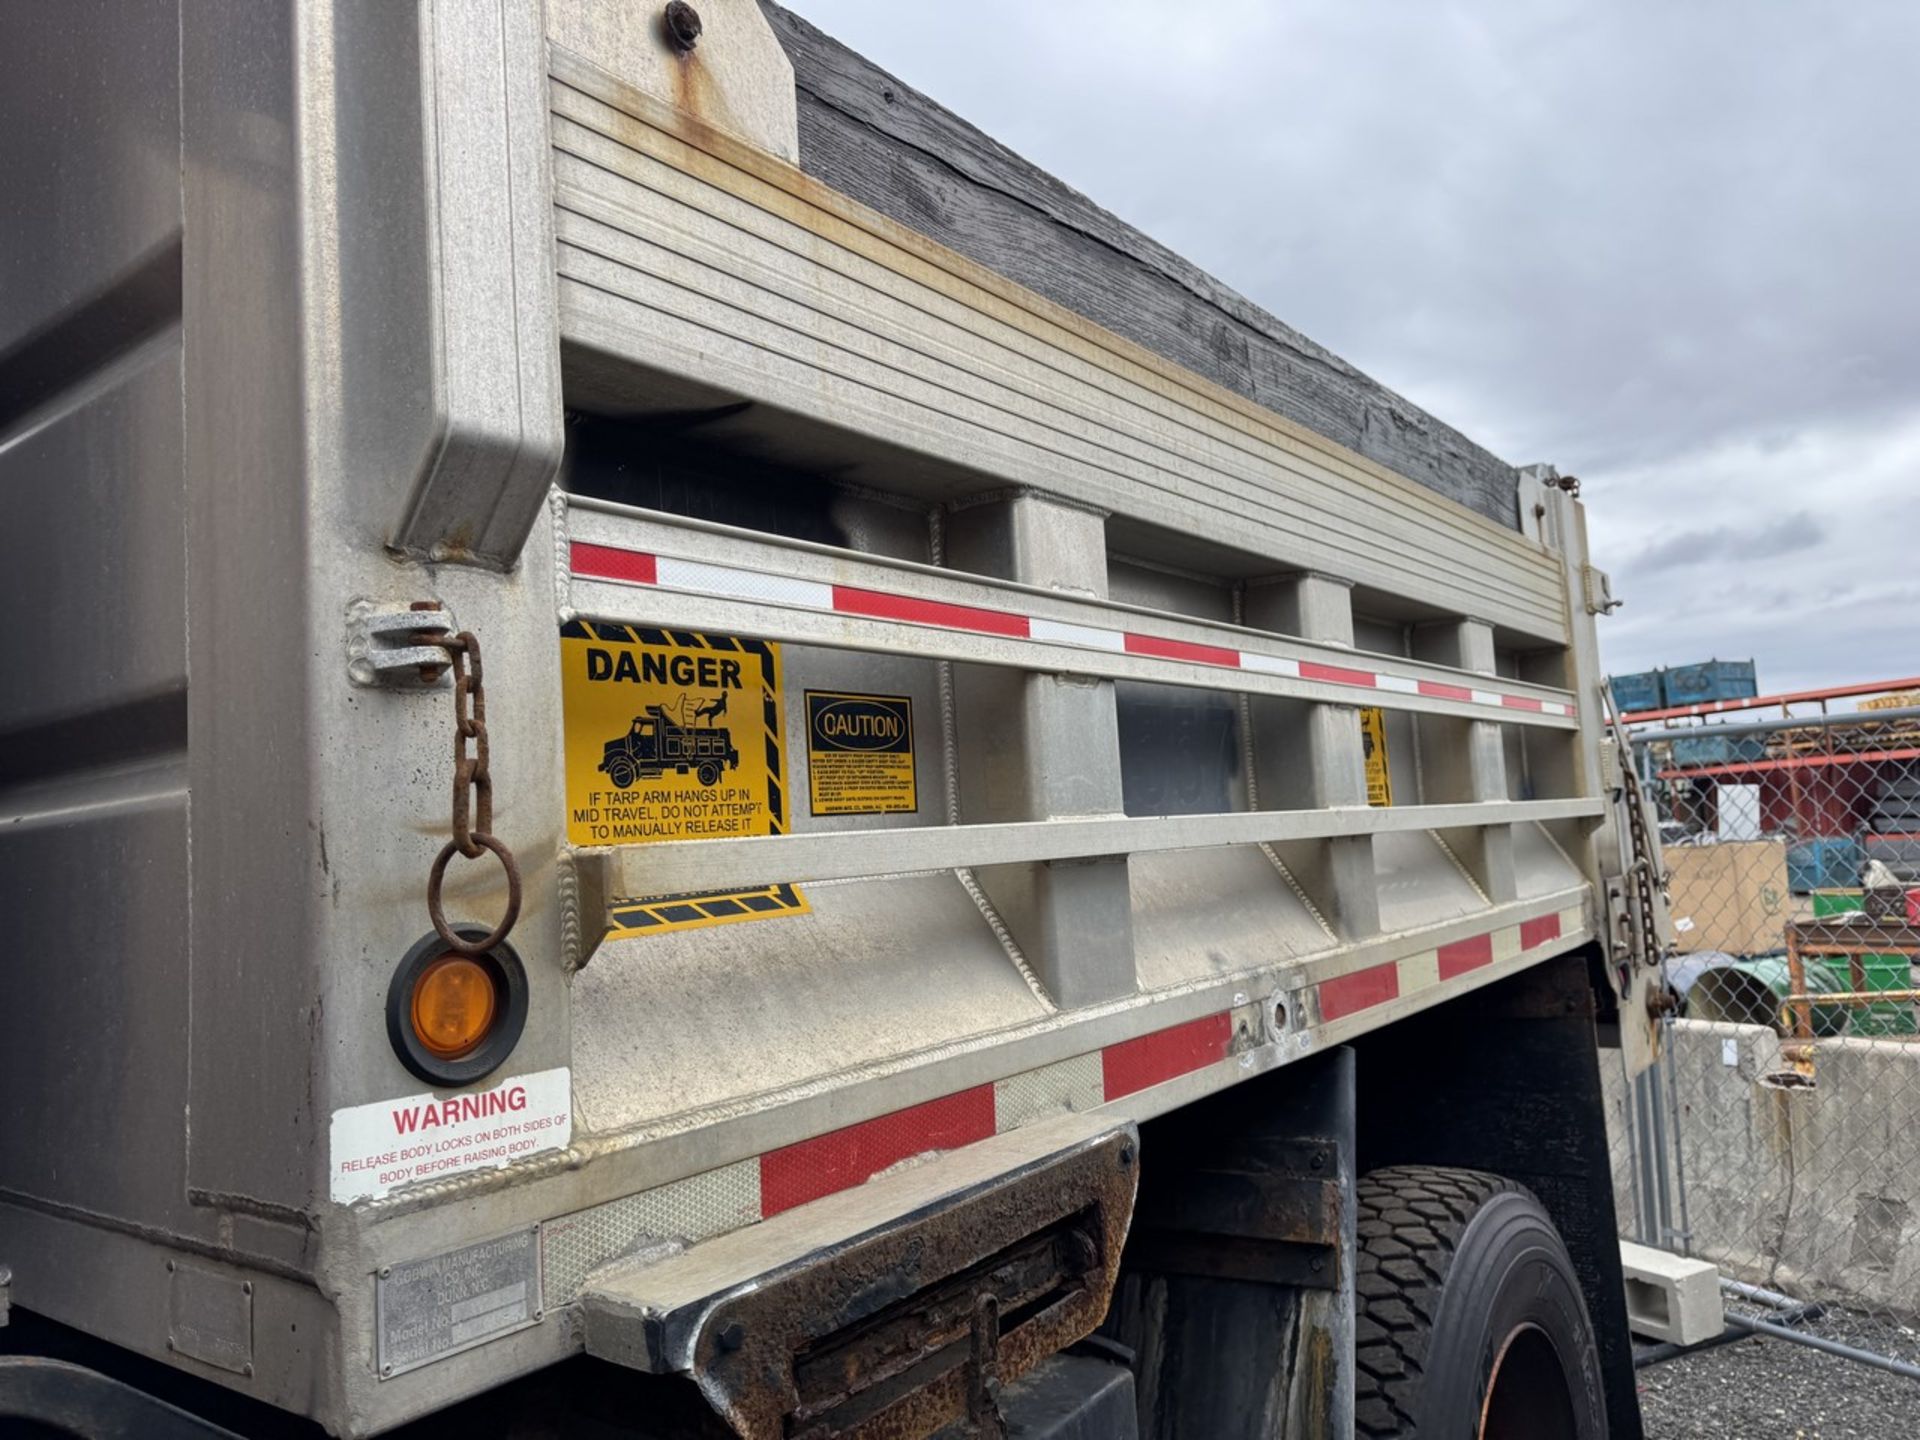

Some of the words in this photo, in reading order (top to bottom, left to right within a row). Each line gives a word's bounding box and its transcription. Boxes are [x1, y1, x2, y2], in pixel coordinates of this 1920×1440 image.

[587, 648, 742, 689] DANGER
[824, 713, 898, 737] CAUTION
[573, 809, 600, 823] MID
[603, 806, 658, 822] TRAVEL,
[661, 805, 680, 820] DO
[684, 804, 709, 818] NOT
[711, 802, 763, 817] ATTEMPT
[589, 792, 601, 806] IF
[605, 791, 640, 806] TARP
[643, 790, 671, 804] ARM
[674, 789, 717, 803] HANGS
[720, 788, 736, 801] UP
[739, 788, 750, 800] IN
[590, 825, 610, 839] TO
[613, 822, 683, 838] MANUALLY
[685, 818, 739, 834] RELEASE
[742, 818, 752, 831] IT
[392, 1086, 526, 1135] WARNING
[341, 1153, 398, 1174] RELEASE
[401, 1143, 433, 1161] BODY
[435, 1135, 472, 1153] LOCKS
[475, 1131, 491, 1144] ON
[493, 1123, 521, 1141] BOTH
[522, 1117, 552, 1135] SIDES
[554, 1113, 568, 1126] OF
[379, 1166, 413, 1185] BODY
[415, 1156, 461, 1176] BEFORE
[463, 1146, 507, 1167] RAISING
[509, 1137, 540, 1155] BODY.
